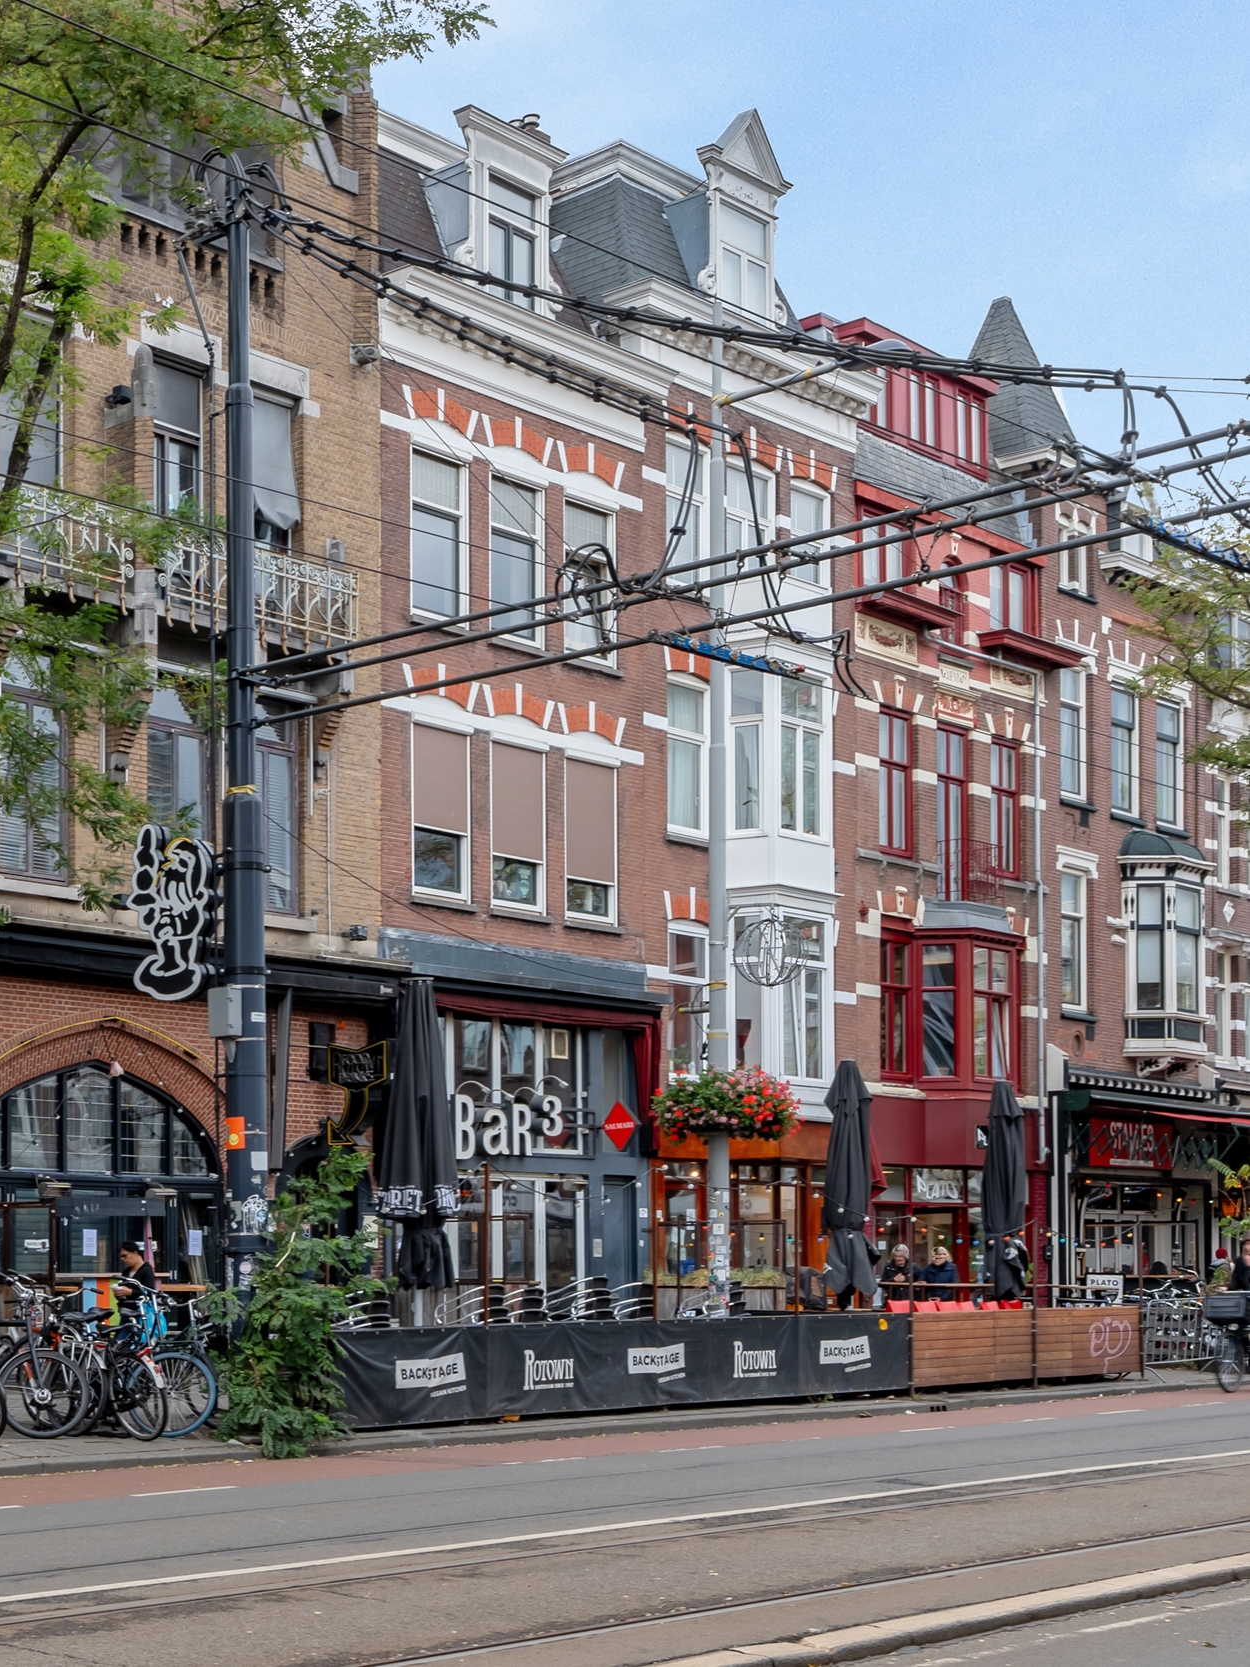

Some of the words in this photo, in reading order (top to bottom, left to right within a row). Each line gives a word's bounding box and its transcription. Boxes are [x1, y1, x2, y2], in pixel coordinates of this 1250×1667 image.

[916, 1174, 959, 1199] PLATO
[632, 1352, 680, 1367] BACKSTAGE
[733, 1341, 777, 1379] ROTOWN
[823, 1344, 865, 1358] BACKSTAGE
[401, 1362, 459, 1381] BACKSTAGE
[523, 1349, 575, 1390] ROTOWN
